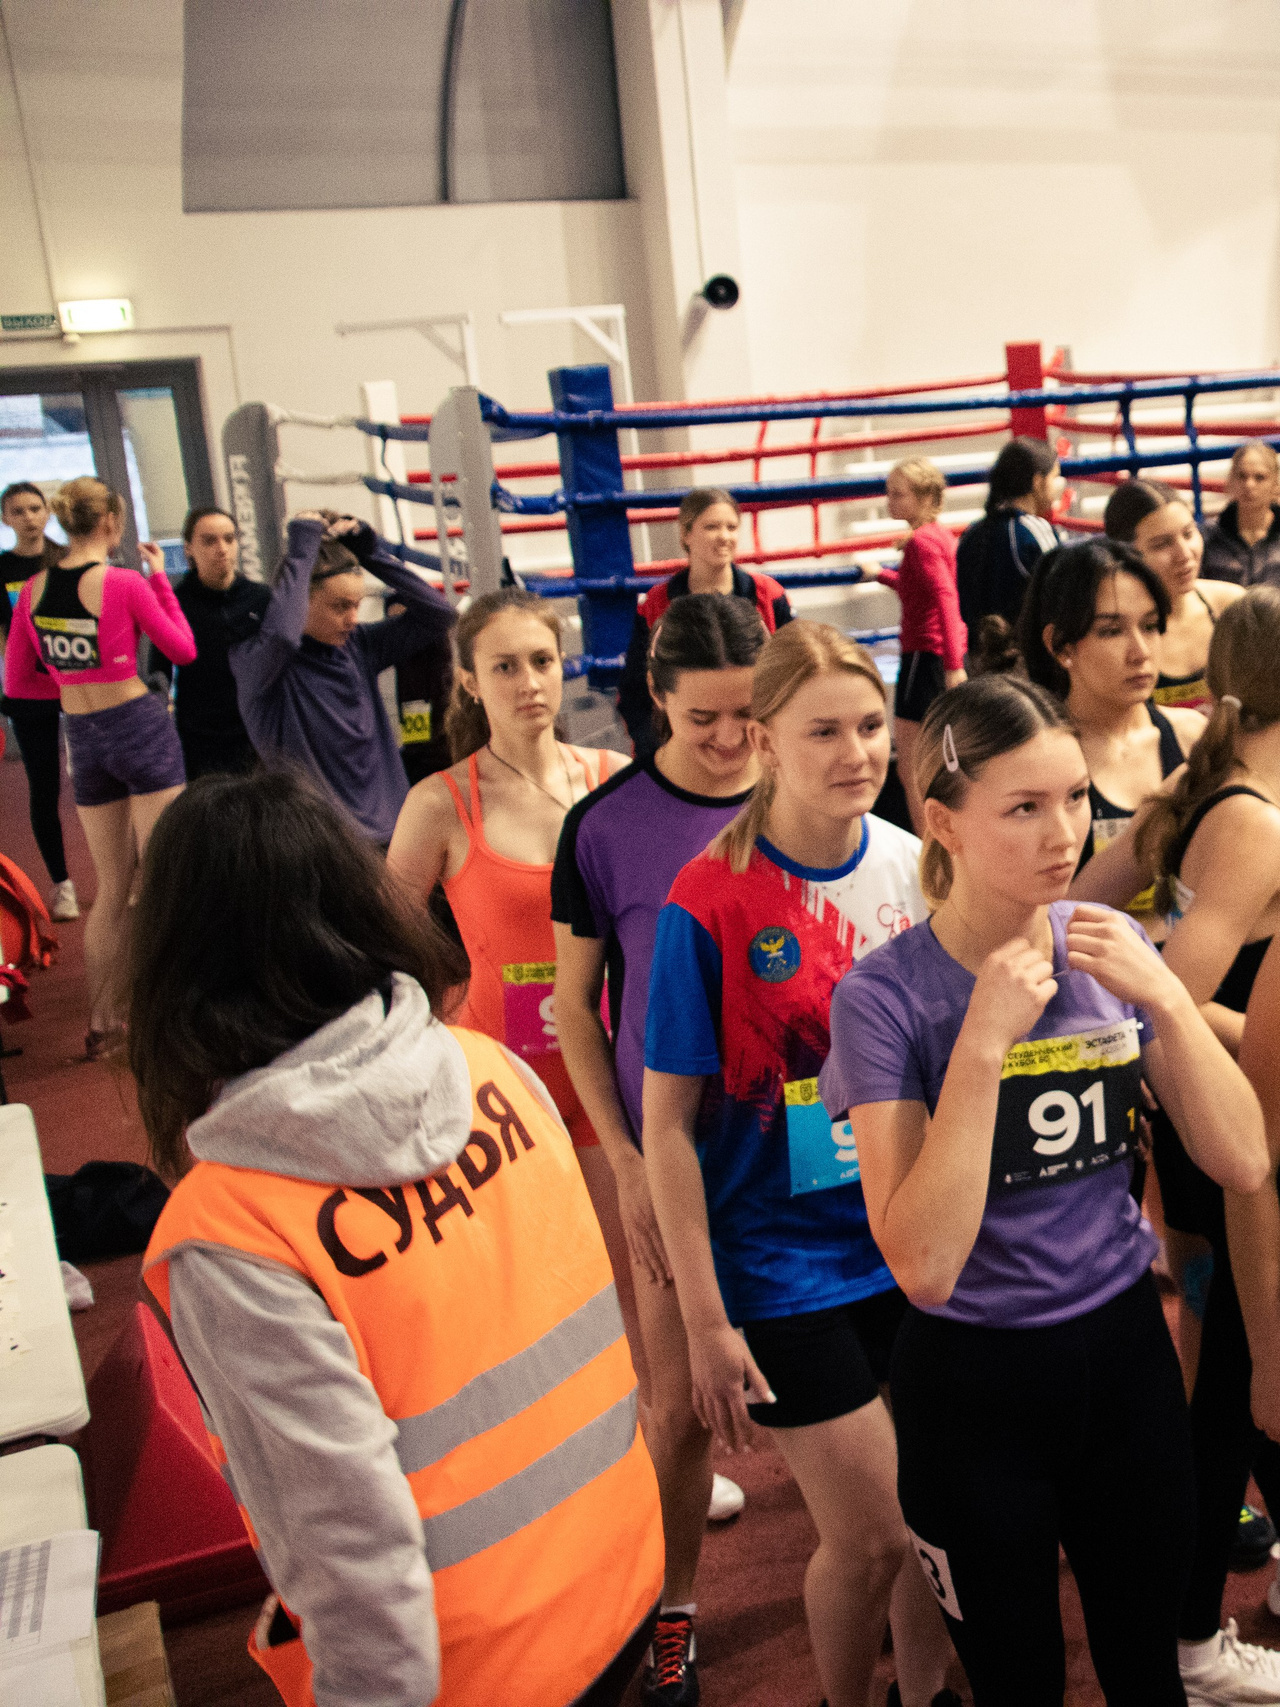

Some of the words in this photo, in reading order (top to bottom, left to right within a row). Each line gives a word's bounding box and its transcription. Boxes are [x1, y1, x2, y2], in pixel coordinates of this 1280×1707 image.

[43, 634, 92, 661] 100
[830, 1119, 859, 1162] 9
[1028, 1080, 1107, 1157] 91
[316, 1080, 537, 1278] СУДЬЯ
